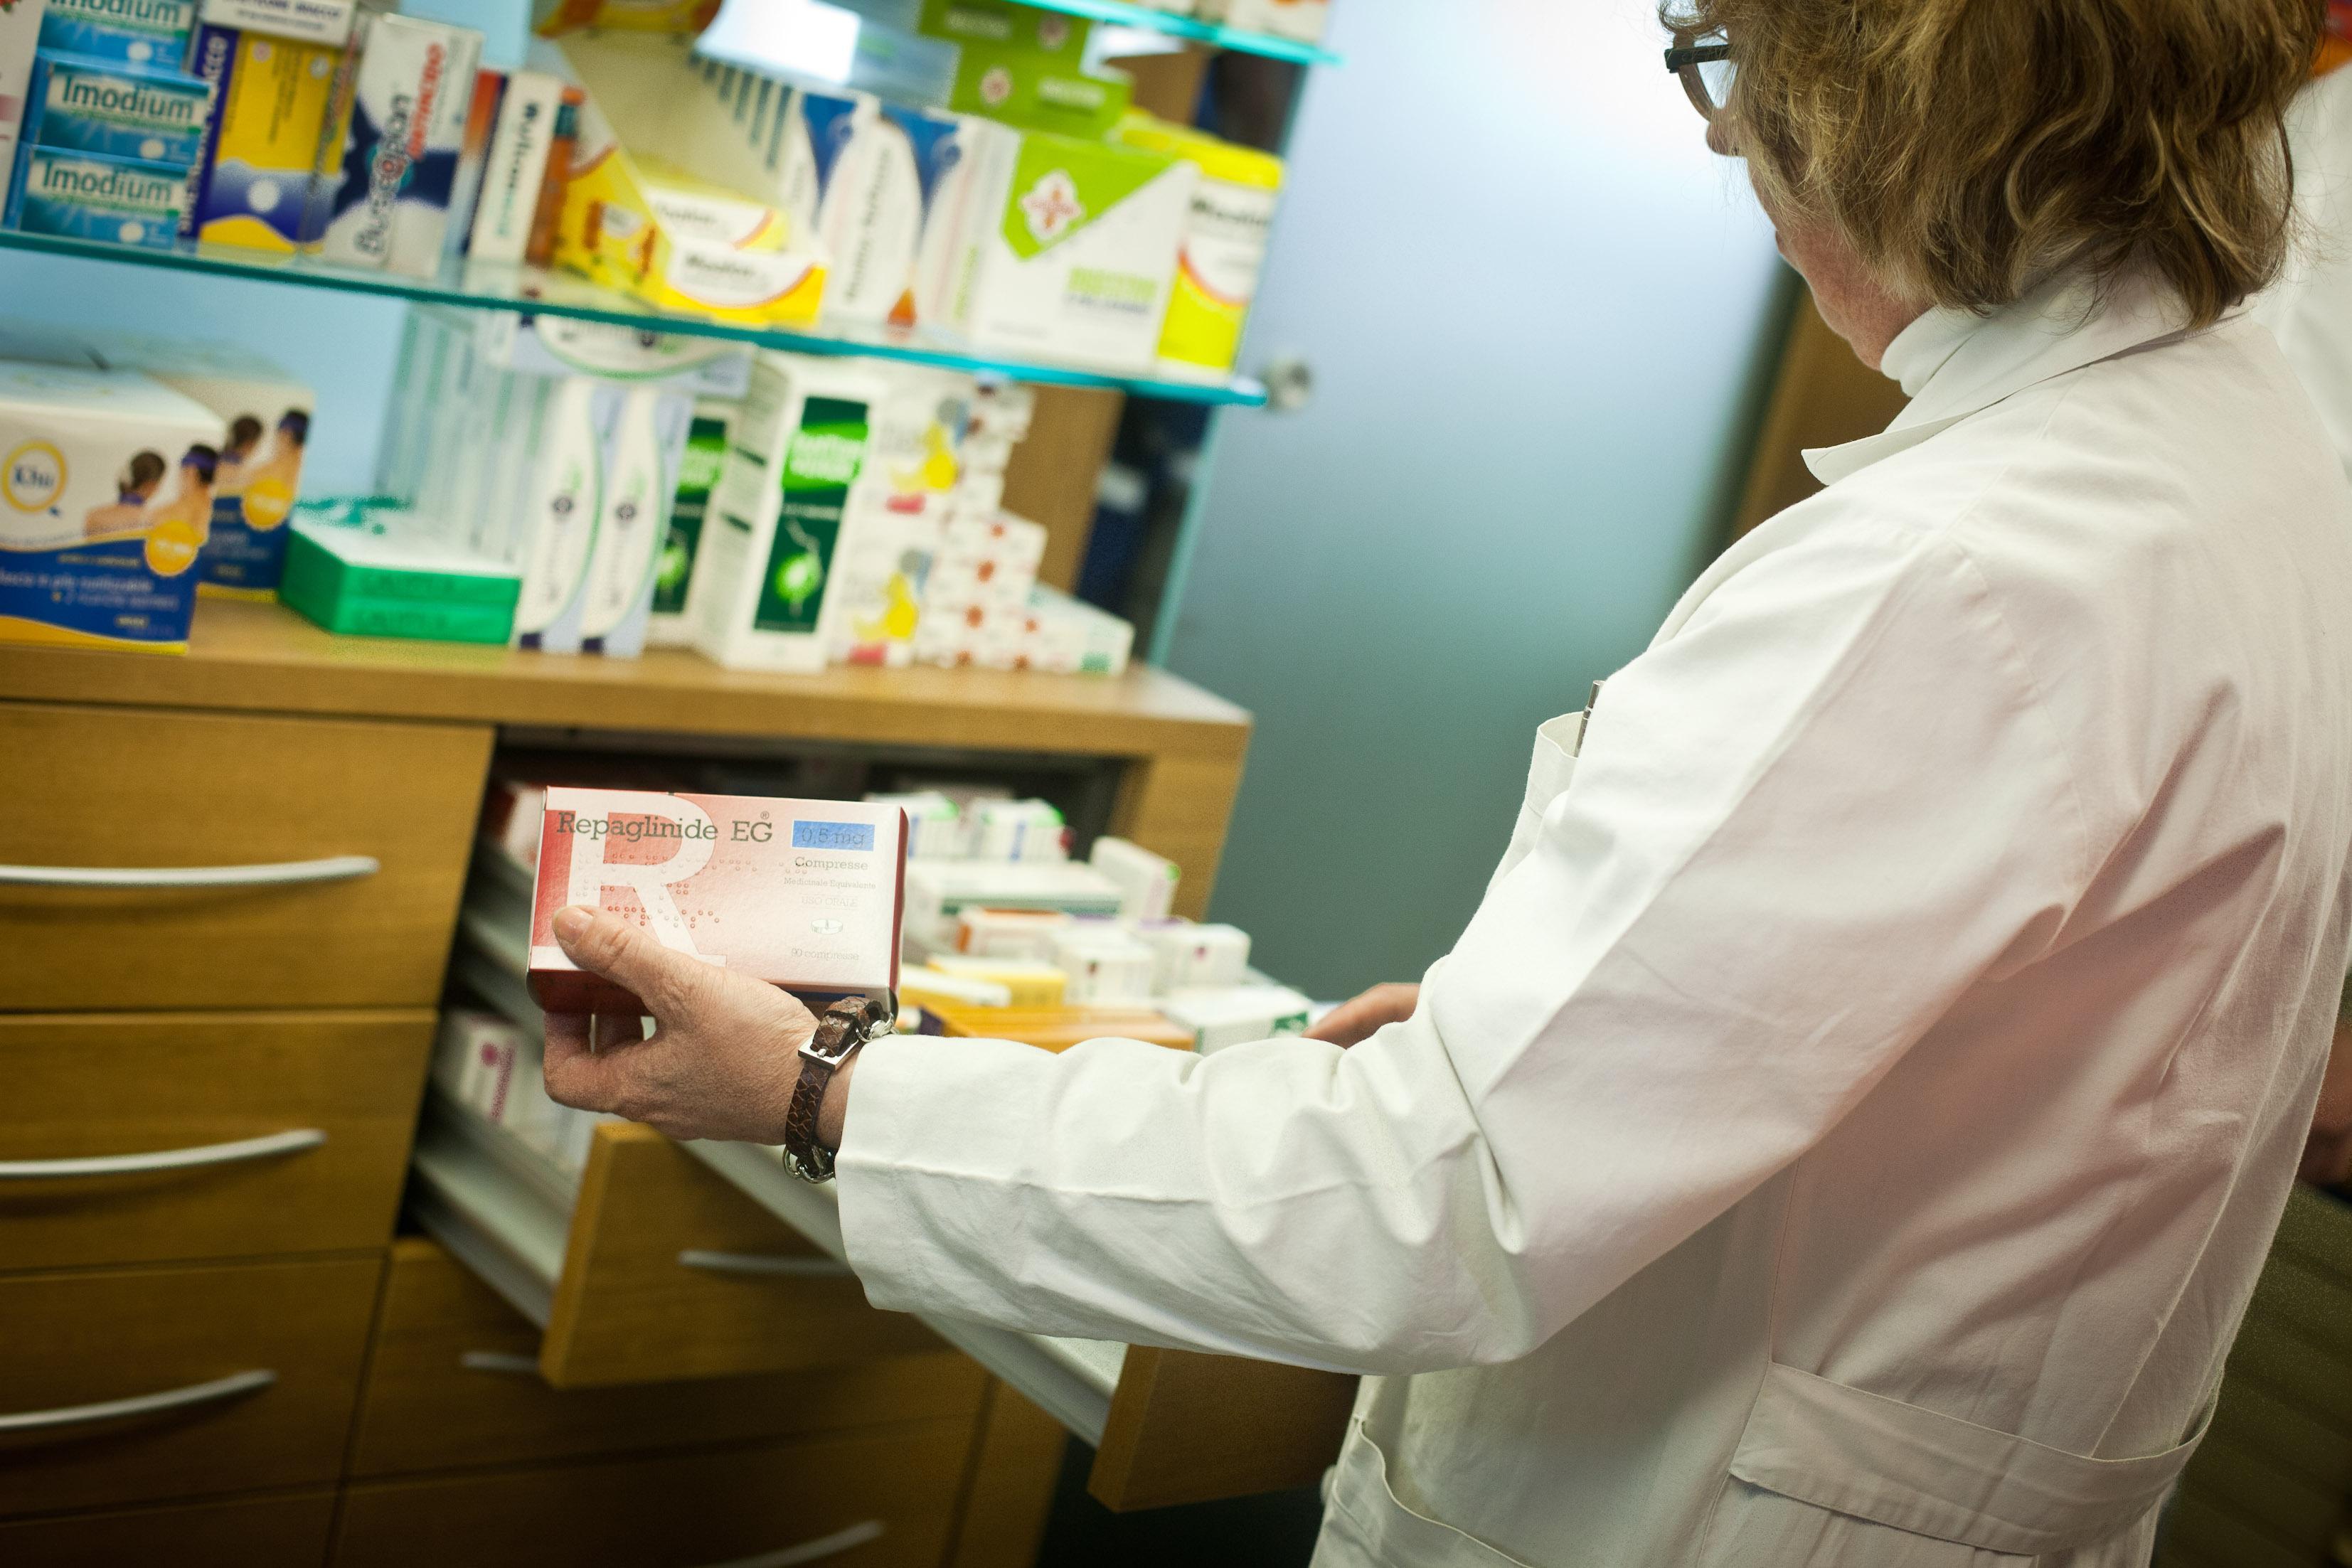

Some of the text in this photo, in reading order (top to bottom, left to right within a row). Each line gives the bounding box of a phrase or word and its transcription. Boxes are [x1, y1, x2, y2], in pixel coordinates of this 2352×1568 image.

[62, 74, 194, 120] Imodium
[43, 161, 172, 203] Imodium
[557, 812, 718, 843] Repaglinide
[801, 826, 866, 849] 0,5 mg
[794, 856, 868, 871] Compresse
[783, 878, 876, 890] Medicinale Equivalente
[801, 895, 823, 906] USO
[791, 947, 860, 961] 90 compresse
